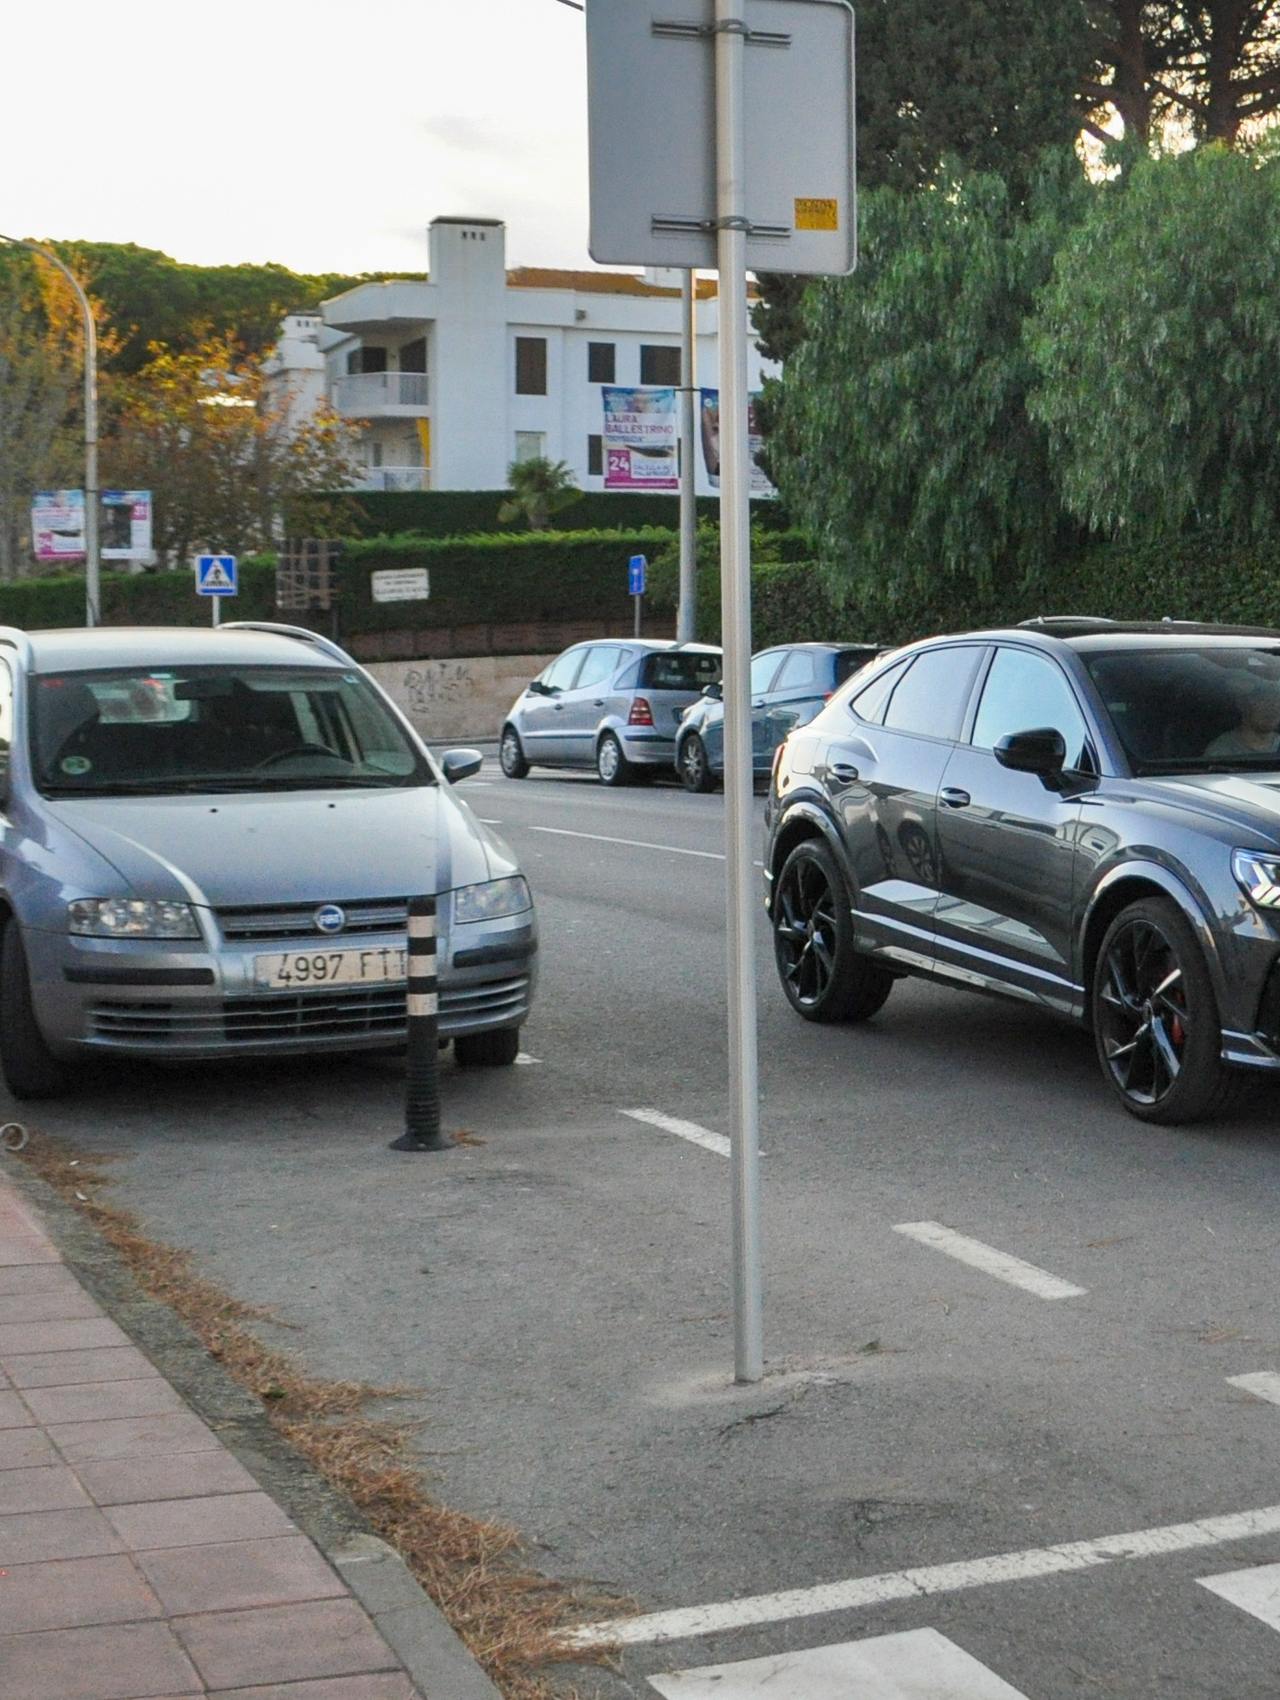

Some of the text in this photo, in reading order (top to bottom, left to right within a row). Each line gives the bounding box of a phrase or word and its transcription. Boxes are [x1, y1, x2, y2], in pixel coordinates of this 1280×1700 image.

[605, 413, 638, 423] LAURA
[605, 423, 674, 434] BALLESTRINO
[609, 456, 630, 471] 24
[278, 953, 343, 982] 4997
